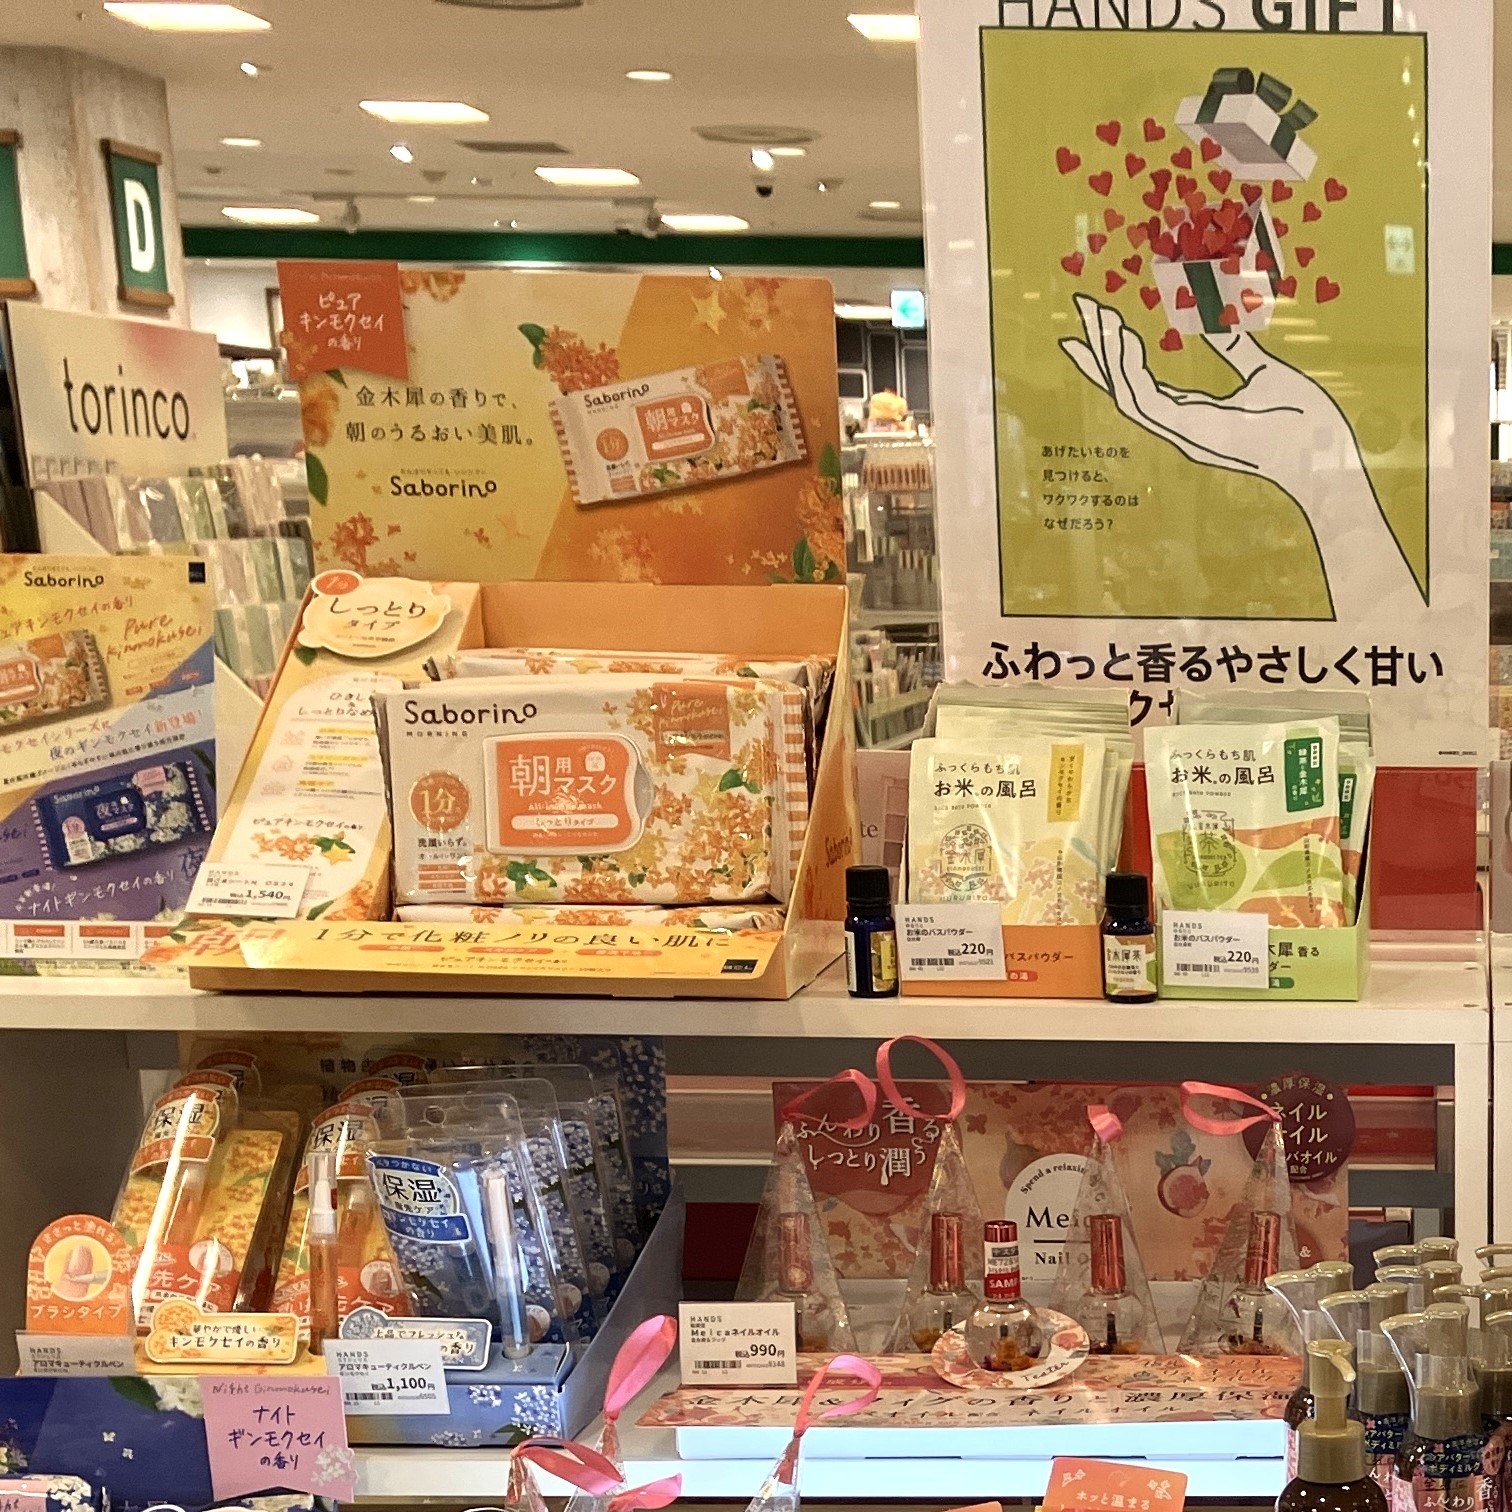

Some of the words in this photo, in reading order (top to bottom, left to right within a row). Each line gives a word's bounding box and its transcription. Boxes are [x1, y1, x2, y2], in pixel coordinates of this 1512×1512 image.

[1000, 0, 1225, 30] HANDS
[125, 178, 154, 273] D
[318, 294, 361, 310] ピュア
[299, 311, 385, 333] キンモクセイ
[327, 335, 362, 352] の香り
[64, 358, 191, 440] torinco
[356, 386, 517, 409] 金木犀の香りで、
[584, 383, 650, 409] Saborino
[346, 423, 533, 445] 朝のうるおい美肌。
[1042, 445, 1131, 459] あげたいものを
[1042, 469, 1110, 483] 見つけると、
[390, 476, 497, 498] Saborino
[1042, 493, 1139, 507] ワクワクするのは
[23, 571, 104, 588] Saborino
[330, 597, 426, 619] しっとり
[347, 619, 401, 631] タイプ
[982, 643, 1443, 685] ふわっと香るやさしく甘い
[405, 700, 537, 725] Saborino
[1170, 749, 1256, 761] ふっくらもち肌
[556, 757, 571, 773] 用
[509, 754, 550, 796] 朝
[554, 774, 617, 795] マスク
[419, 788, 454, 812] 1分
[1174, 935, 1240, 943] お米のバスパウダー
[948, 943, 993, 956] 税込220円
[1214, 952, 1259, 965] 税込220円
[383, 1172, 439, 1203] 保湿
[1034, 1252, 1071, 1265] Nail
[31, 1304, 123, 1319] ブラシタイプ
[30, 1347, 61, 1355] HANDS
[169, 1335, 281, 1350] キンモクセイの香り
[735, 1344, 785, 1358] 税込990円
[32, 1359, 124, 1369] アロマキューティクルペン
[339, 1362, 431, 1372] アロマキューティクルペン
[371, 1377, 436, 1391] 税込1,100円
[252, 1405, 295, 1426] ナイト
[228, 1430, 326, 1449] ギンモクセイ
[261, 1454, 298, 1470] の香り
[1076, 1491, 1150, 1510] ホッと温まる
